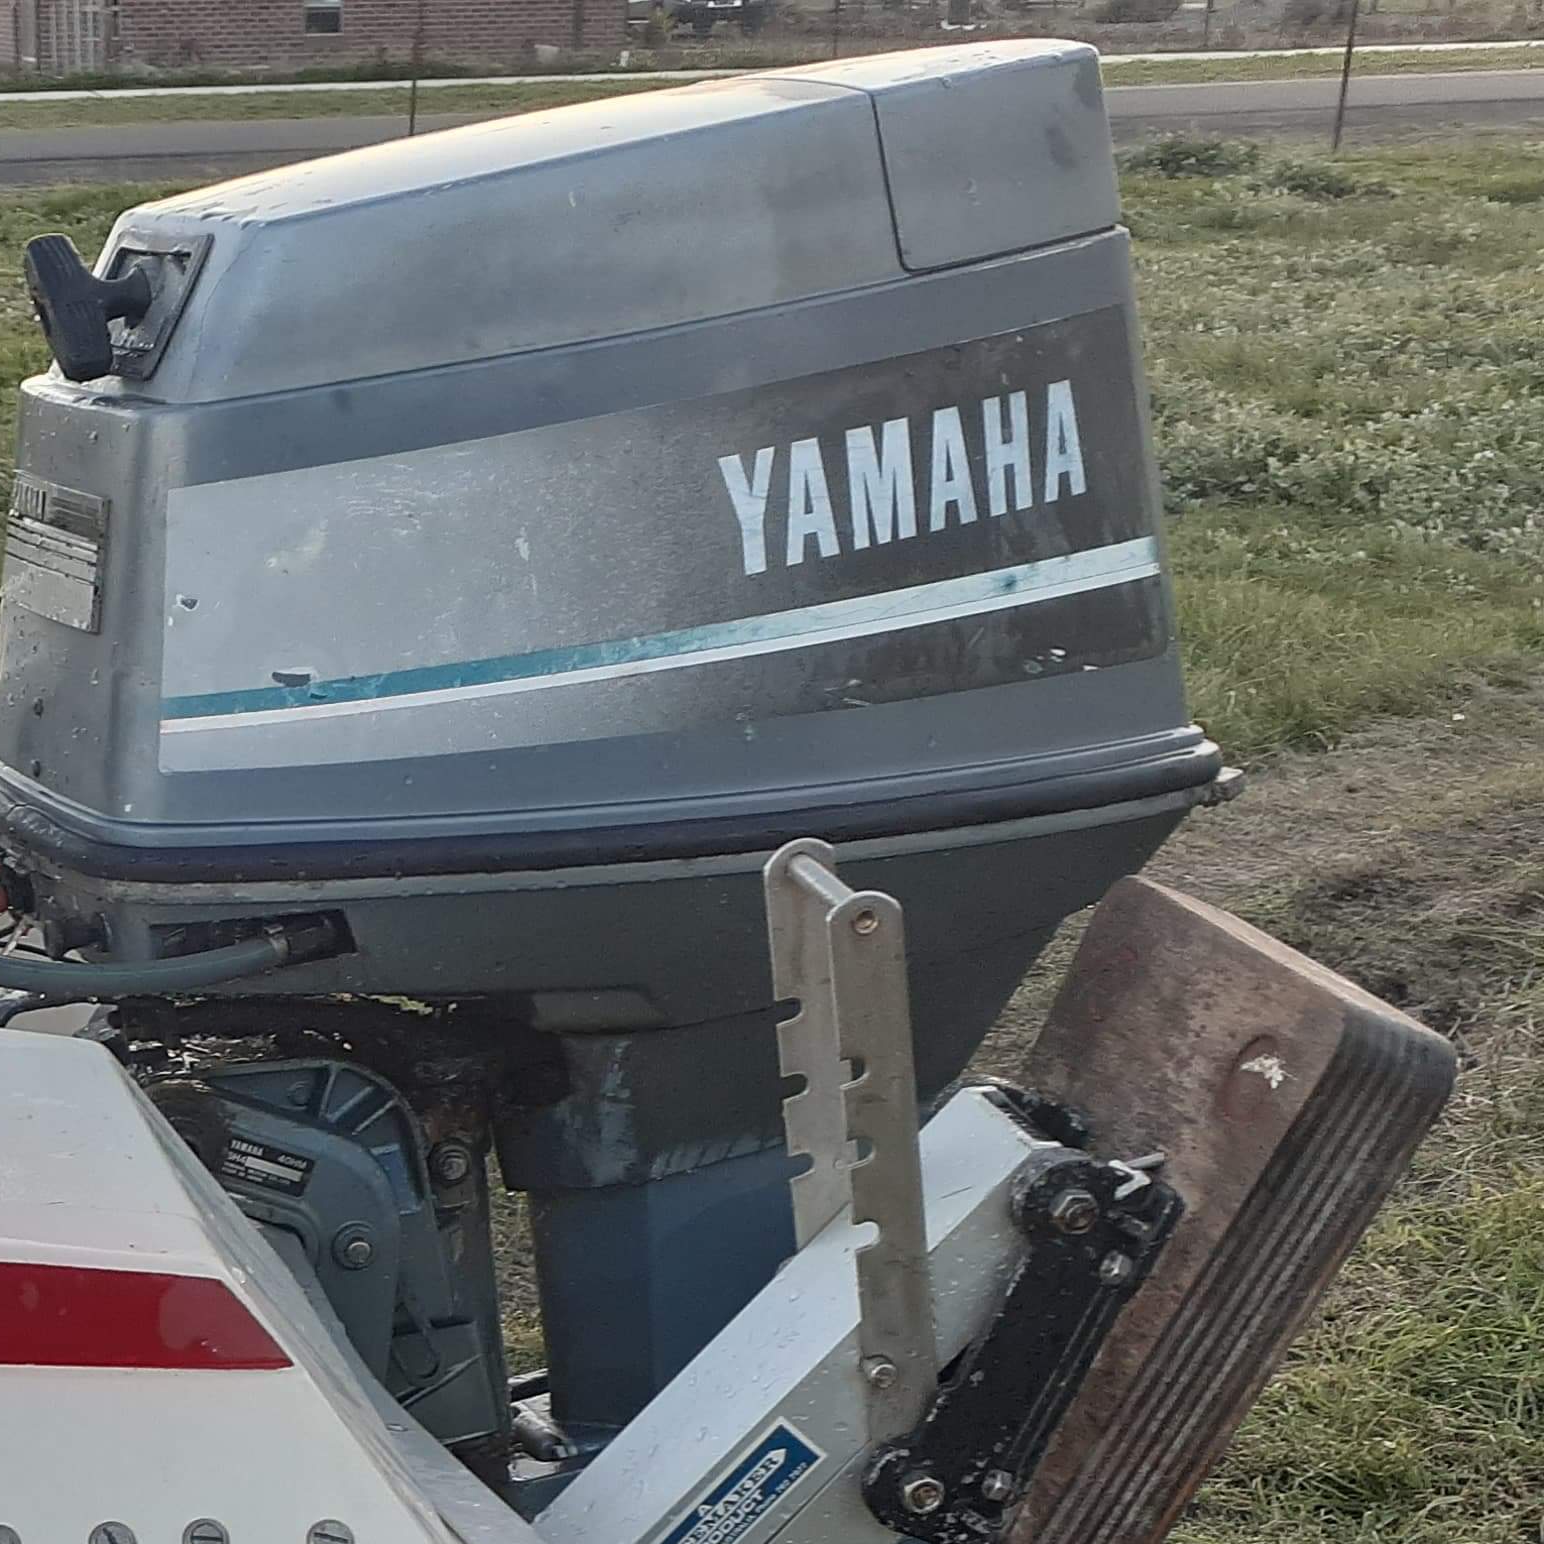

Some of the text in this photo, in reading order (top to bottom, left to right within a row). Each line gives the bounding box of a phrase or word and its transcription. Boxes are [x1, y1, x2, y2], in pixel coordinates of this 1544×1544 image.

[718, 380, 1086, 576] YAMAHA
[230, 1140, 264, 1156] YAMAHA
[697, 1504, 713, 1518] A
